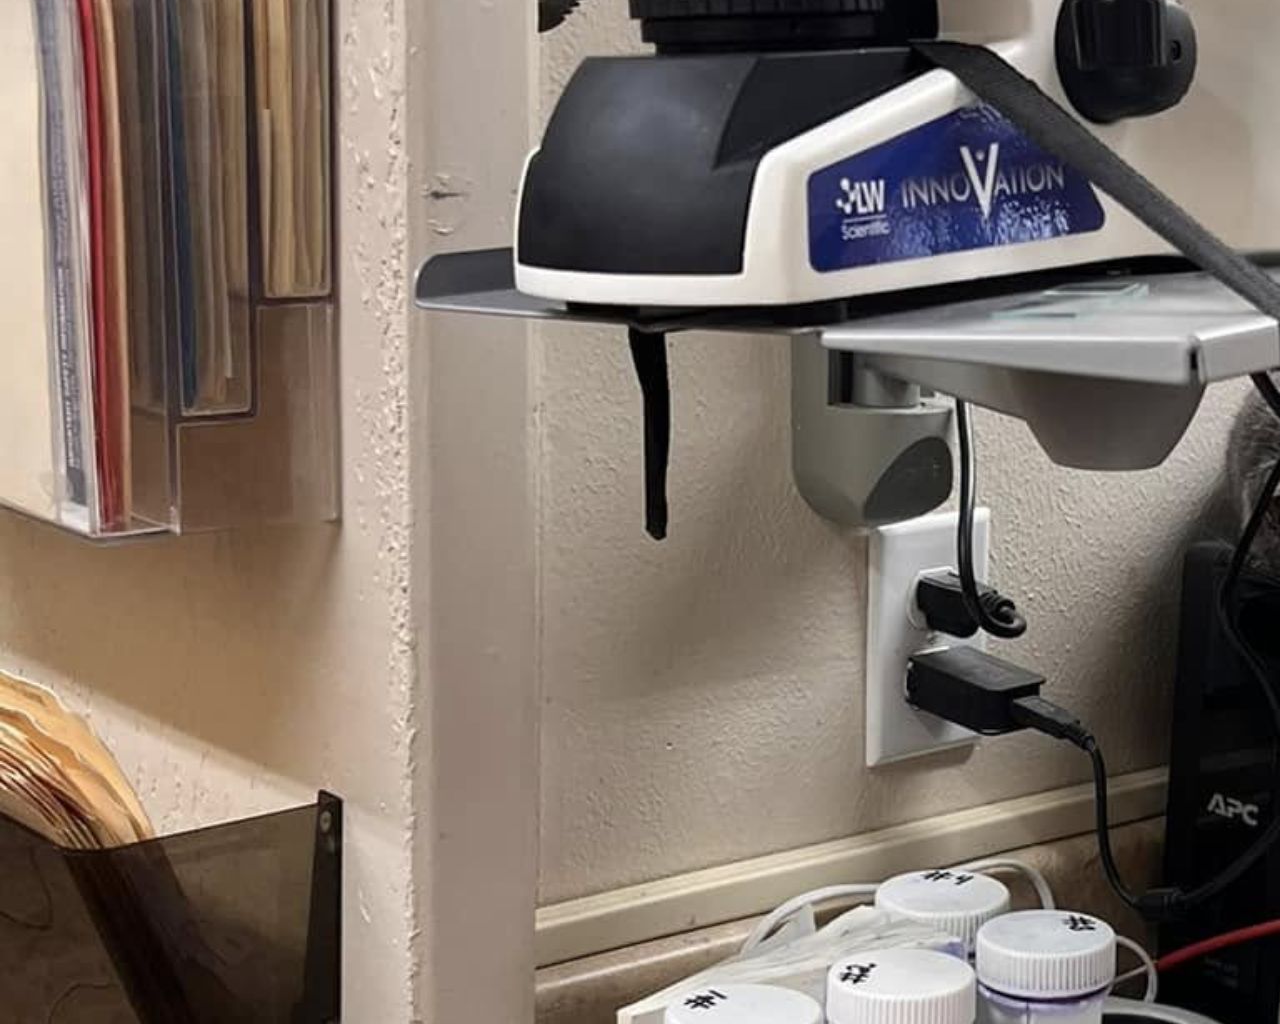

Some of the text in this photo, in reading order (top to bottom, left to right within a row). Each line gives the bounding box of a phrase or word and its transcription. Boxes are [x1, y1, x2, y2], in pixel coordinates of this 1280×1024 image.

[856, 179, 885, 212] LW
[902, 142, 1065, 219] INNOVATION
[841, 220, 891, 241] Scientific
[1207, 793, 1259, 826] APC
[683, 989, 728, 1011] #1
